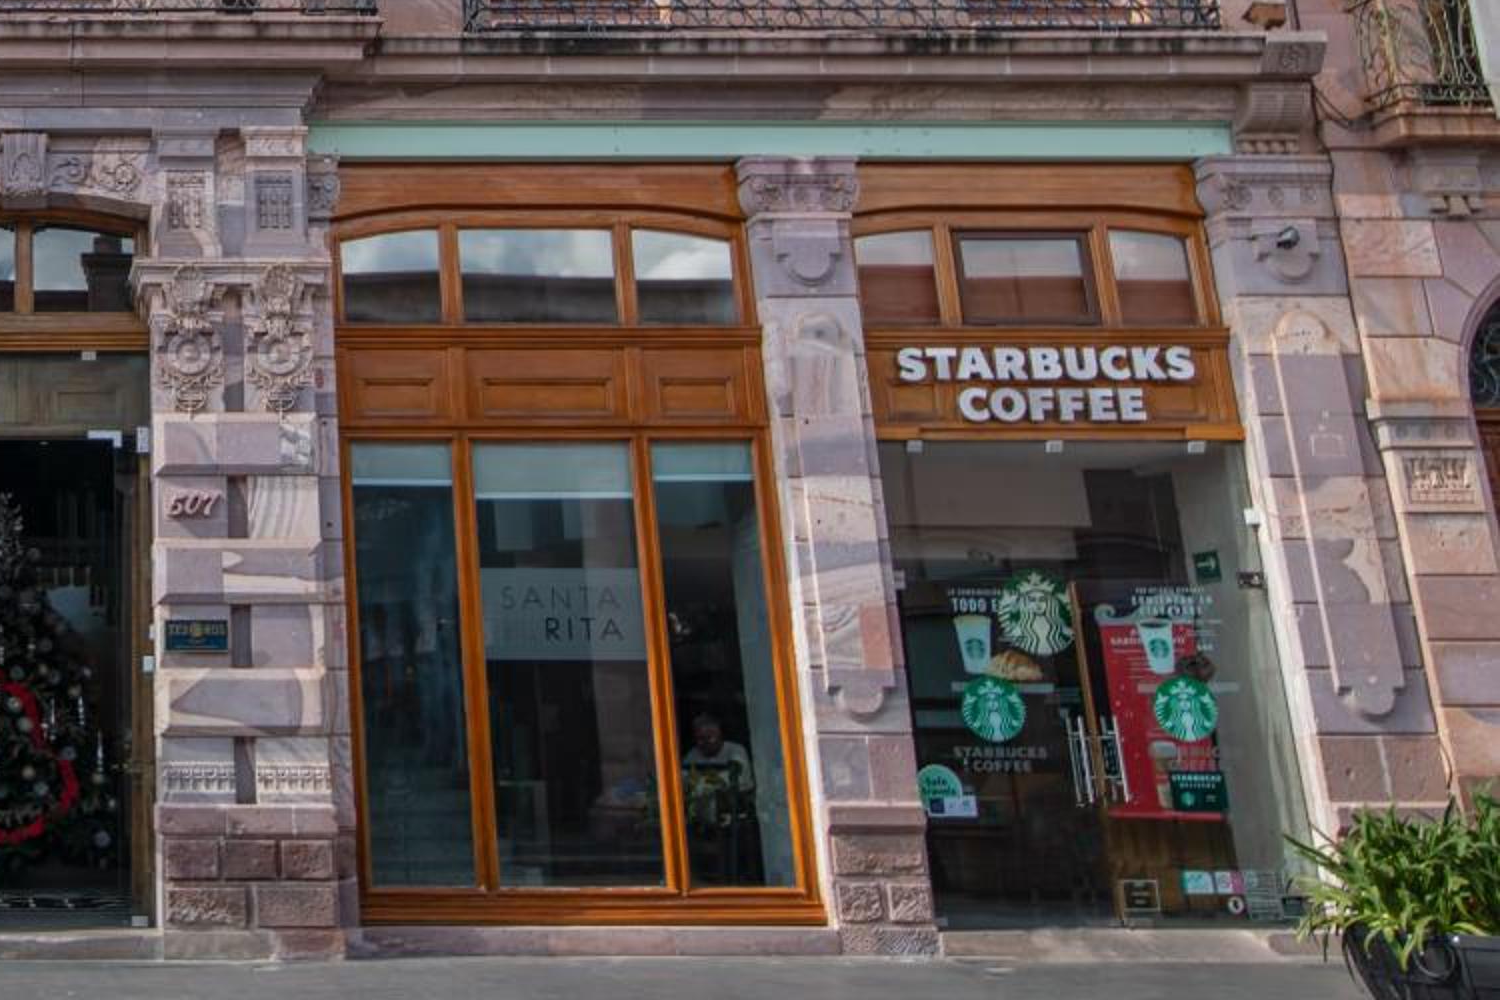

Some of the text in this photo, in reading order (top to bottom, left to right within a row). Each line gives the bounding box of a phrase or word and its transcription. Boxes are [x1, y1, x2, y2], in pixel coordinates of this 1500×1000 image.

[897, 346, 1196, 381] STARBUCKS
[958, 387, 1148, 422] COFFEE
[167, 492, 221, 519] 507
[501, 585, 621, 610] SANTA
[545, 616, 625, 641] RITA
[953, 745, 1048, 760] STARBUCKS
[972, 759, 1033, 773] COFFEE
